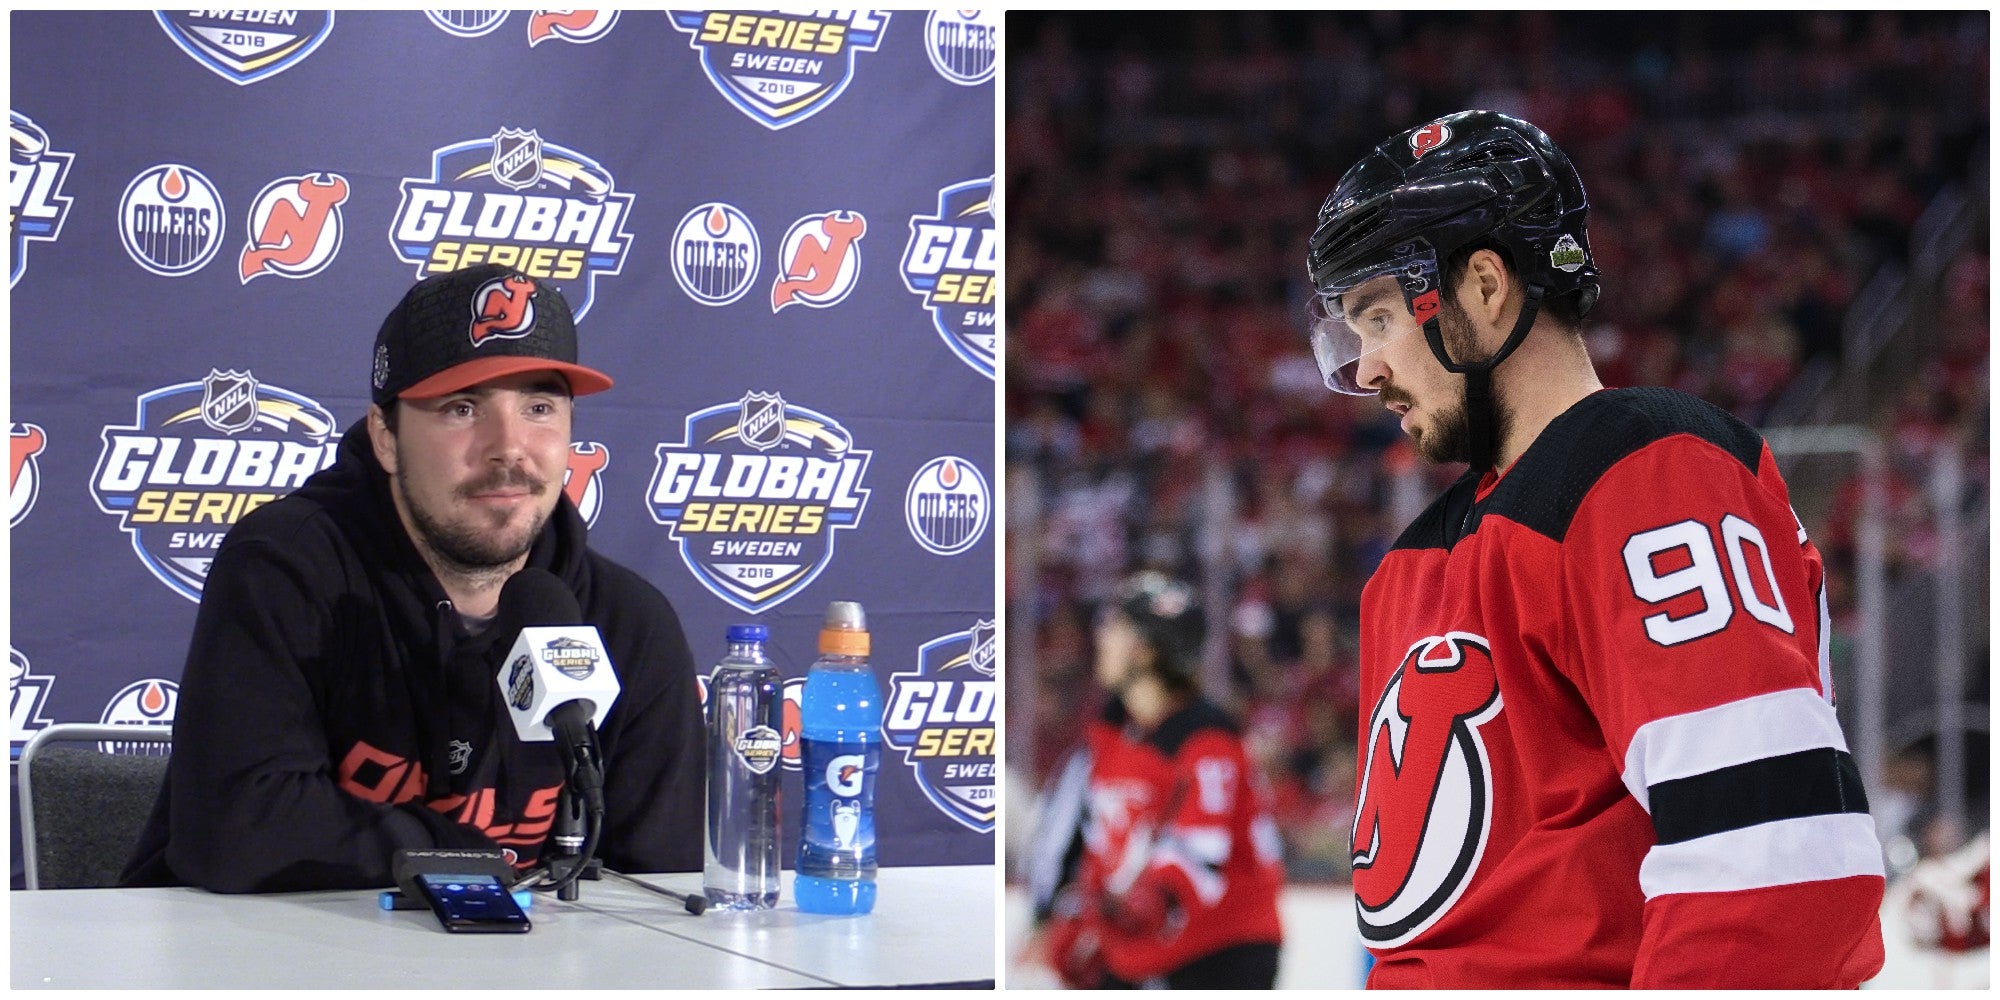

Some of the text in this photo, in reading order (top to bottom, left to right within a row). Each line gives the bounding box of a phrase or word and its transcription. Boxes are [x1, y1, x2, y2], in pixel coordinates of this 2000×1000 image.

[221, 32, 265, 47] 2018
[700, 12, 847, 54] SERIES
[731, 53, 823, 75] SWEDEN
[758, 82, 795, 95] 2018
[503, 143, 534, 175] NHL
[134, 204, 211, 237] OILERS
[398, 188, 623, 253] GLOBAL
[683, 240, 749, 269] OILERS
[215, 386, 247, 419] NHL
[750, 408, 777, 437] NHL
[653, 453, 861, 508] GLOBAL
[678, 503, 825, 534] SERIES
[917, 493, 979, 519] OILERS
[710, 541, 801, 557] SWEDEN
[737, 567, 773, 579] 2018
[1621, 513, 1795, 647] 90
[888, 681, 995, 730] GLO
[914, 728, 995, 757] SER
[825, 754, 865, 797] G
